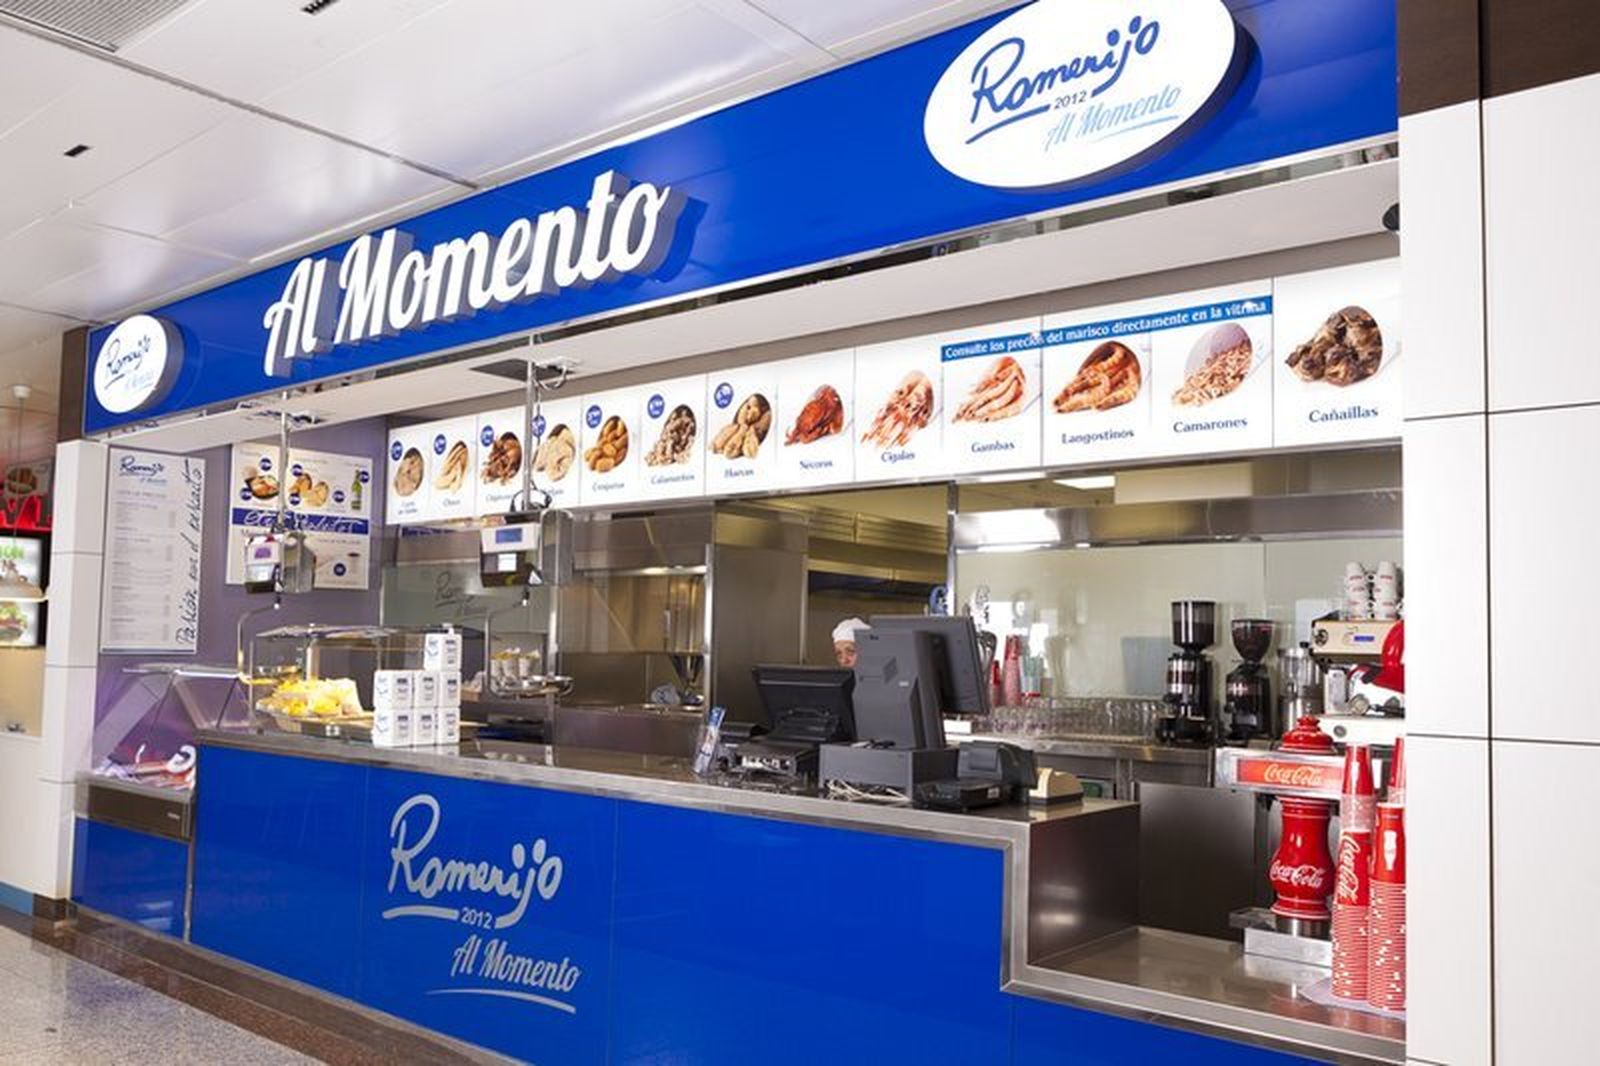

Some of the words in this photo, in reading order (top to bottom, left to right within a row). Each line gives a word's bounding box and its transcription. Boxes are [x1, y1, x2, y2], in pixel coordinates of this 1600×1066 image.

[970, 16, 1160, 123] Romerijo
[1044, 113, 1072, 152] Al
[1076, 84, 1182, 140] Momento
[1054, 90, 1088, 109] 2012
[263, 257, 327, 377] Al
[334, 169, 670, 345] Momento
[945, 342, 988, 359] Consulte
[989, 340, 1005, 352] los
[1046, 331, 1063, 344] del
[1065, 325, 1110, 341] marisco
[1112, 313, 1189, 334] directamente
[1191, 310, 1208, 322] en
[1210, 306, 1222, 318] la
[1172, 416, 1248, 434] Camarones
[1308, 405, 1379, 422] Cañaillas
[971, 440, 1015, 454] Gambas
[1061, 428, 1135, 446] Langostinos
[388, 794, 563, 928] Romerijo
[461, 907, 492, 929] 2012
[450, 934, 482, 977] Al
[479, 938, 582, 992] Momento
